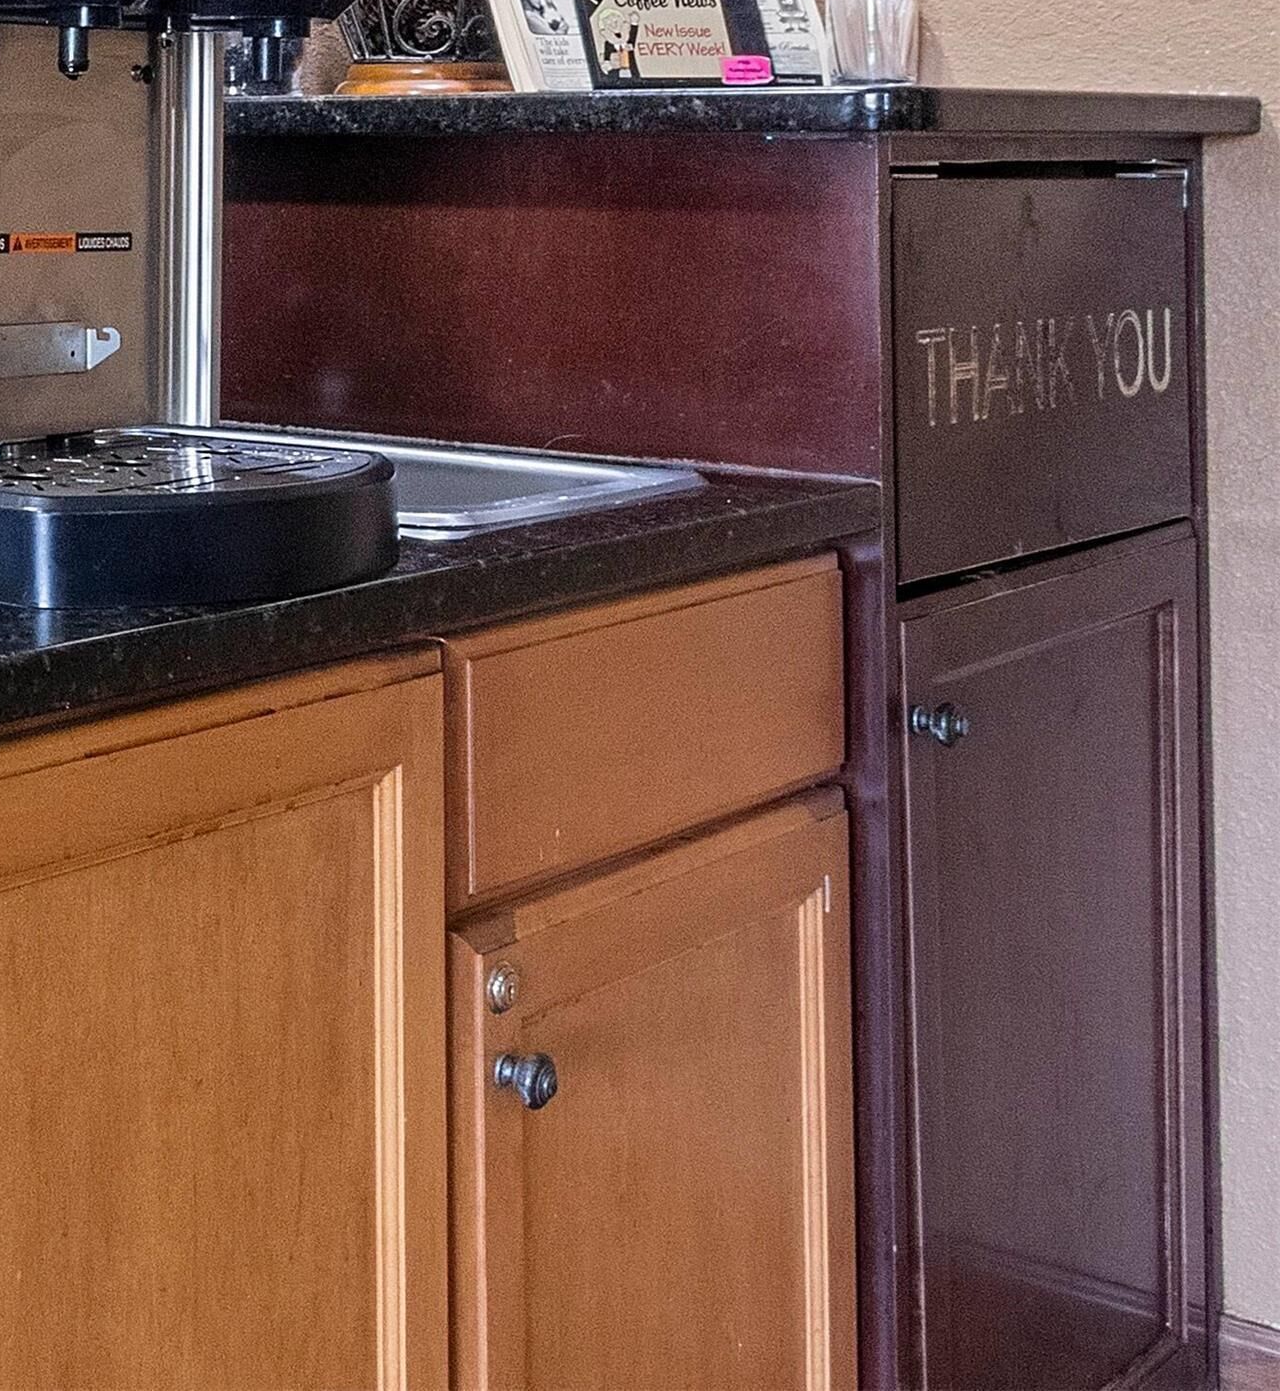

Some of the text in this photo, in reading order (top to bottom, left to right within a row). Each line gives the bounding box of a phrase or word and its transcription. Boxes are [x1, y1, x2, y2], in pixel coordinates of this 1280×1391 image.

[644, 24, 712, 38] New Issue
[637, 42, 726, 56] EVERY Week!
[915, 307, 1172, 427] THANK YOU
